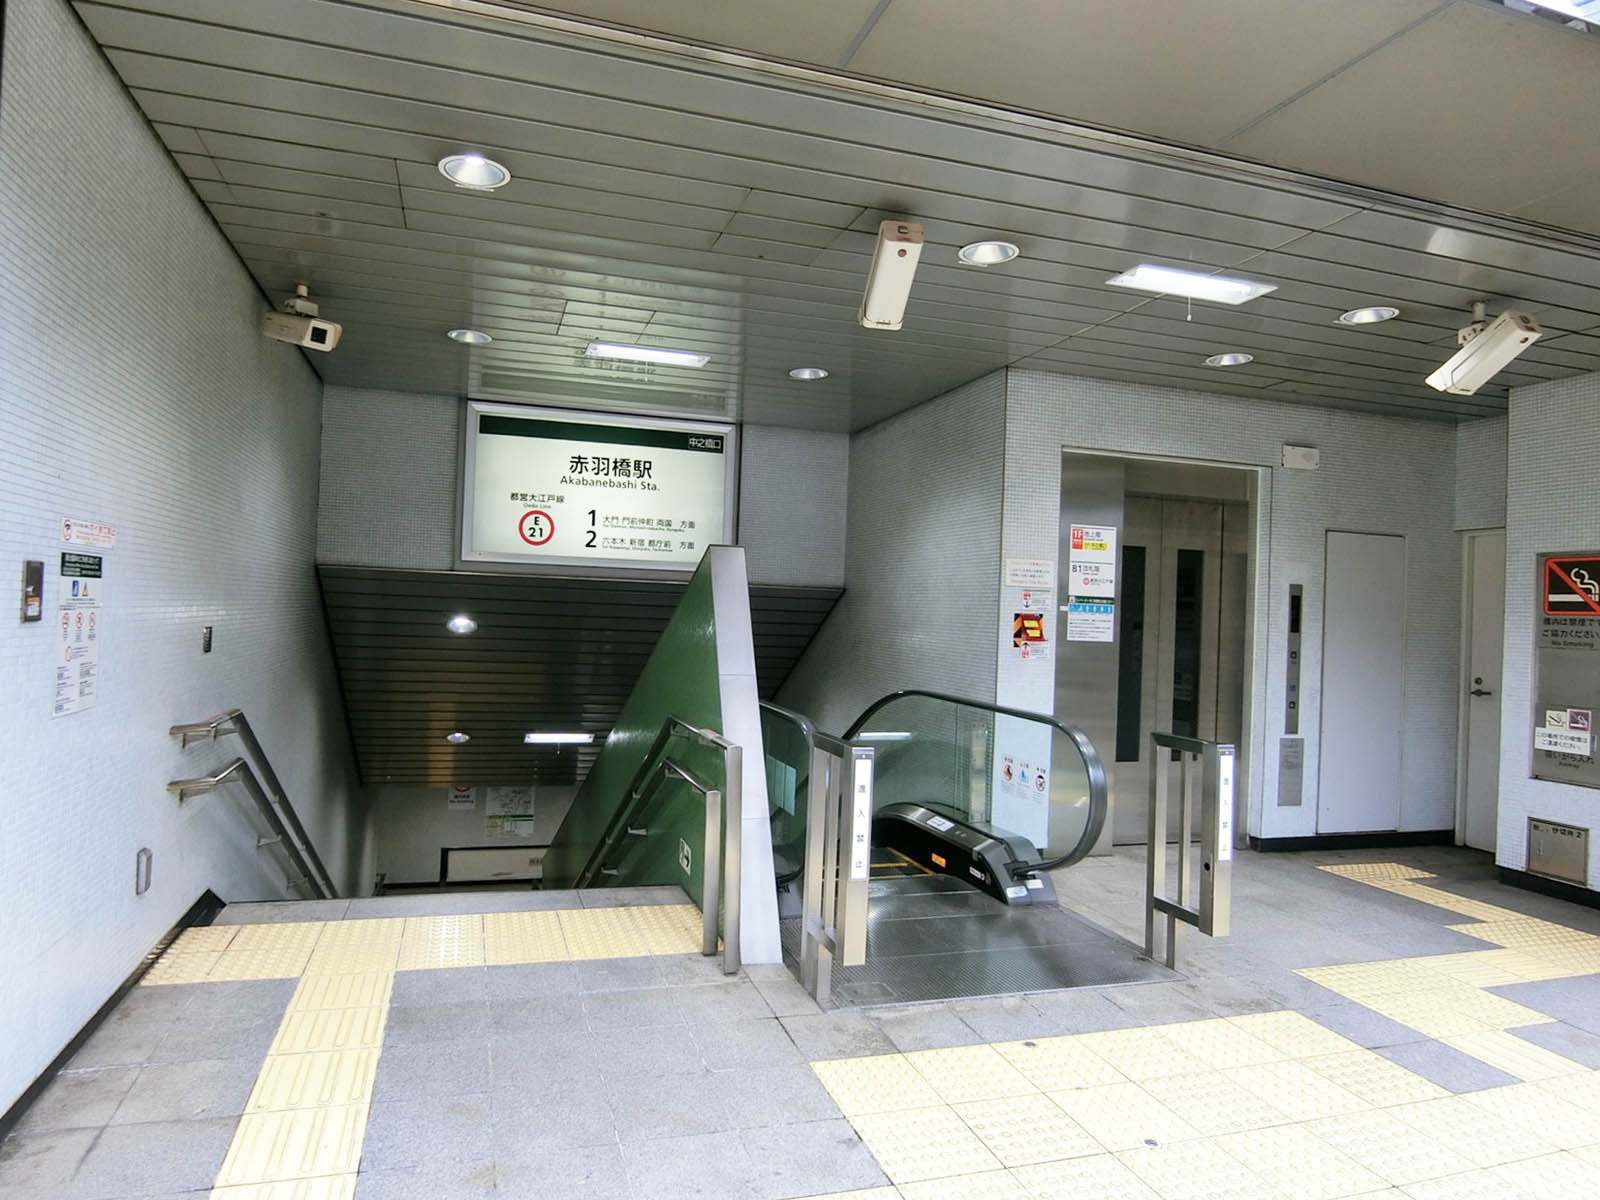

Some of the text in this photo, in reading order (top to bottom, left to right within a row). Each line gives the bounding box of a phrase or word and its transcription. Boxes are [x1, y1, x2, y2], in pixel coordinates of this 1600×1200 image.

[569, 454, 652, 479] 赤羽橋駅
[560, 475, 660, 491] Akabanebashi Sta.
[510, 491, 565, 503] 都営大江戸線
[534, 516, 540, 526] E
[587, 509, 596, 527] 1
[602, 515, 619, 525] 大門
[622, 516, 654, 526] 門前仲町
[656, 518, 673, 528] 両国
[680, 520, 696, 529] 方面
[528, 527, 543, 537] 21
[585, 530, 597, 548] 2
[602, 536, 626, 546] 六本木
[630, 538, 645, 547] 新宿
[679, 541, 695, 550] 方面
